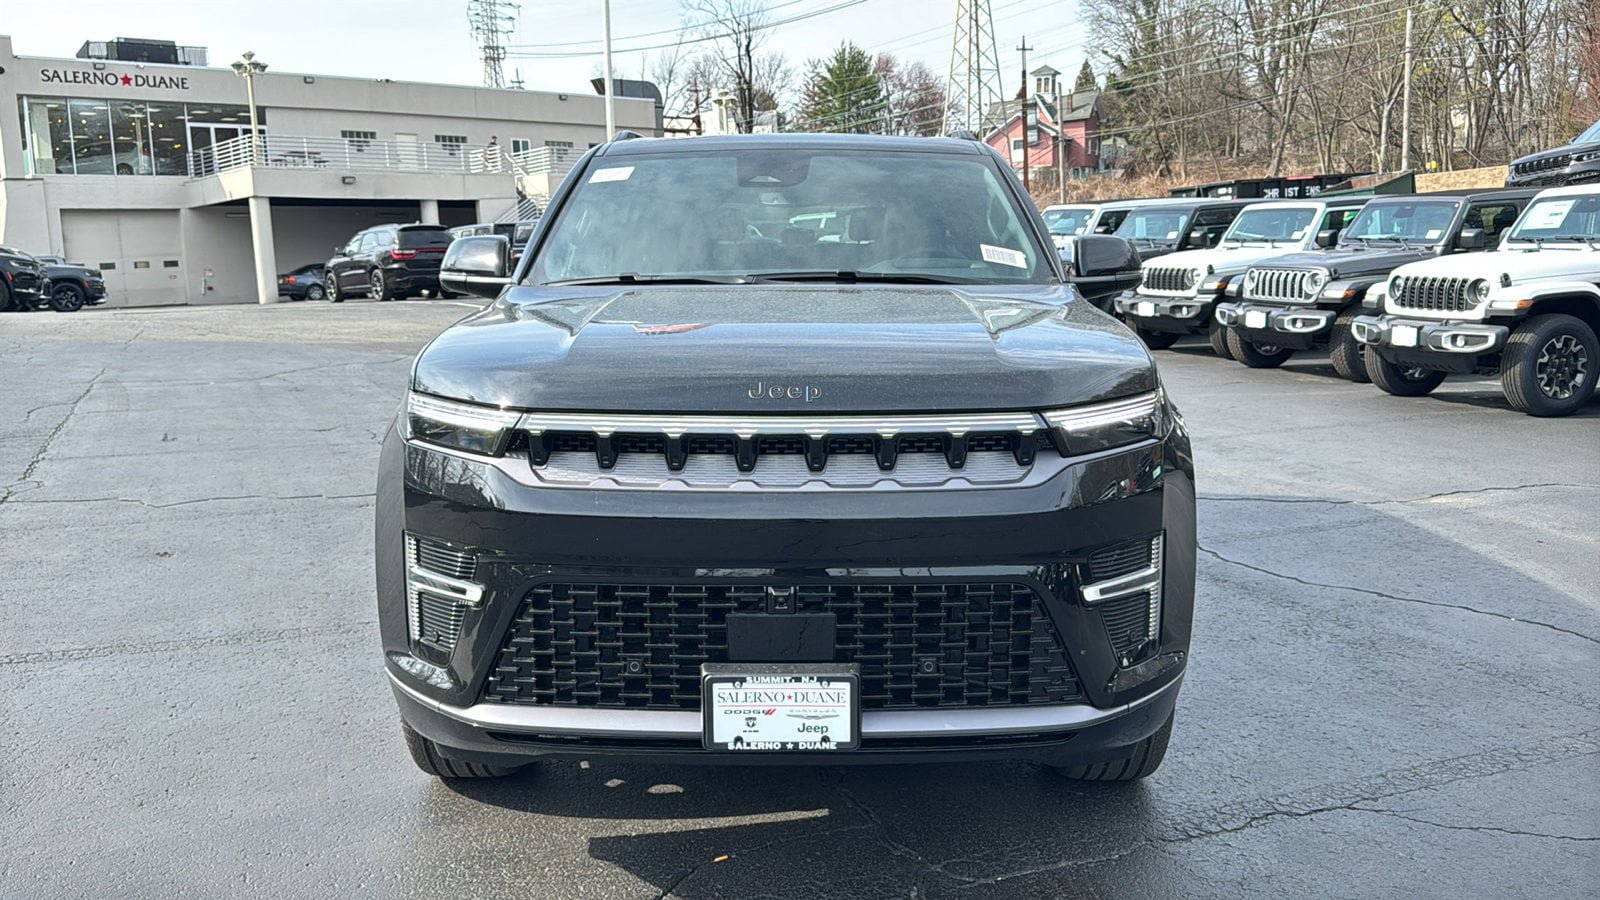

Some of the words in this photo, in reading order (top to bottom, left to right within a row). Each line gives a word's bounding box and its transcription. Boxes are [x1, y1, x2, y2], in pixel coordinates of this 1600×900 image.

[41, 69, 118, 86] SALERNO
[134, 74, 189, 90] DUANE
[748, 381, 822, 402] Jeep
[717, 691, 785, 704] SALERNO
[794, 691, 846, 704] DUANE
[797, 722, 829, 735] Jeep
[727, 742, 781, 750] SALERNO
[799, 742, 837, 750] DUANE
